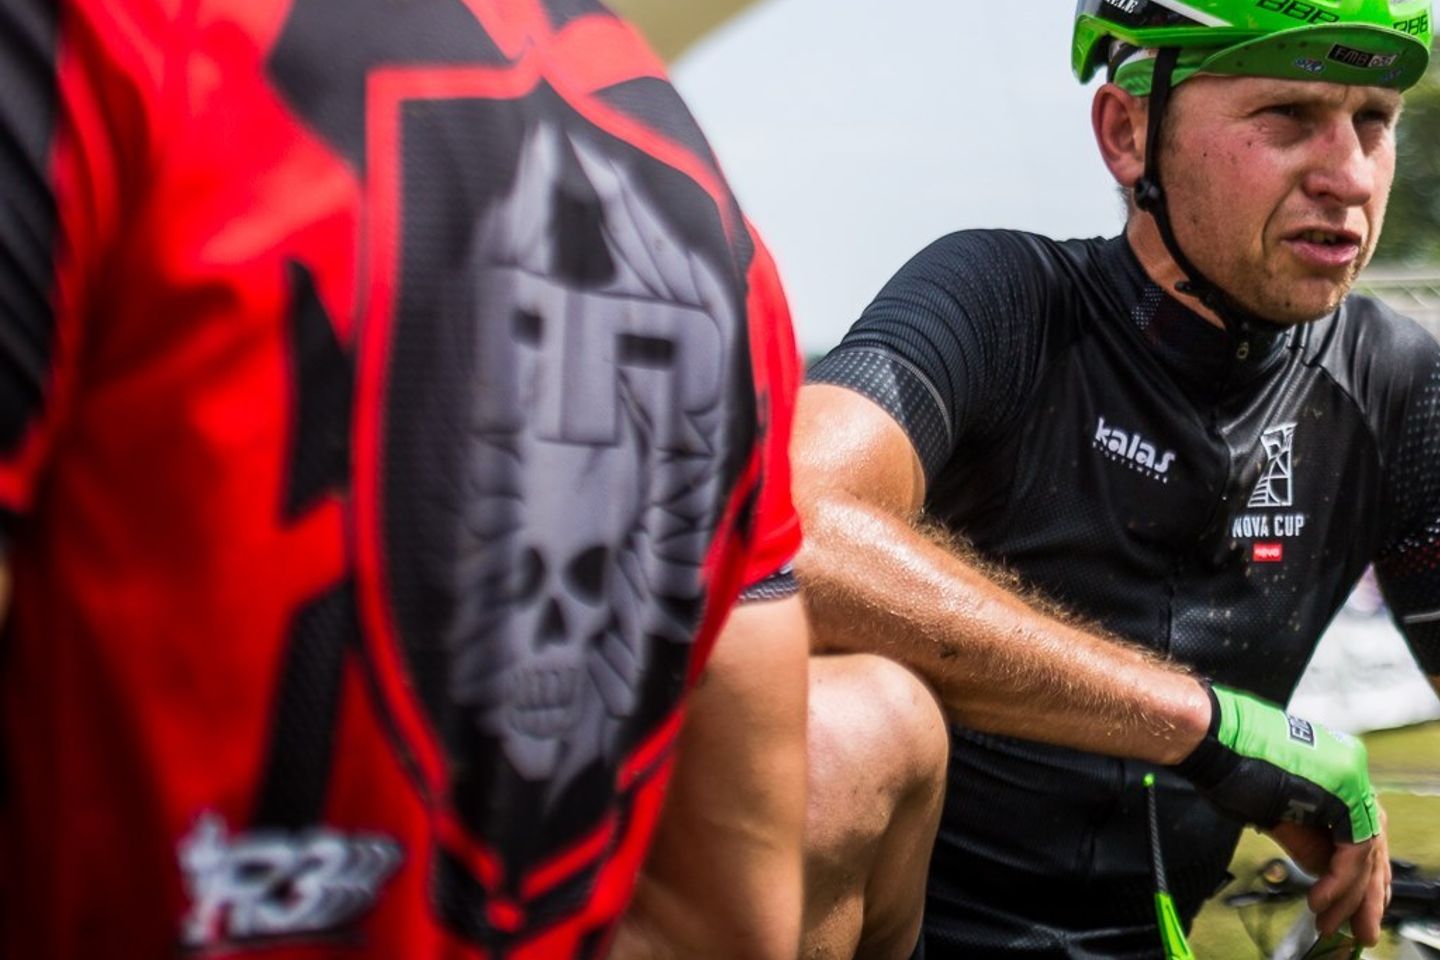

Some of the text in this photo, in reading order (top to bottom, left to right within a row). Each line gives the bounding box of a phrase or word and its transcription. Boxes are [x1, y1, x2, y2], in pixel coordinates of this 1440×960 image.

[1095, 417, 1175, 473] kalas
[1232, 515, 1304, 537] NOVA CUP
